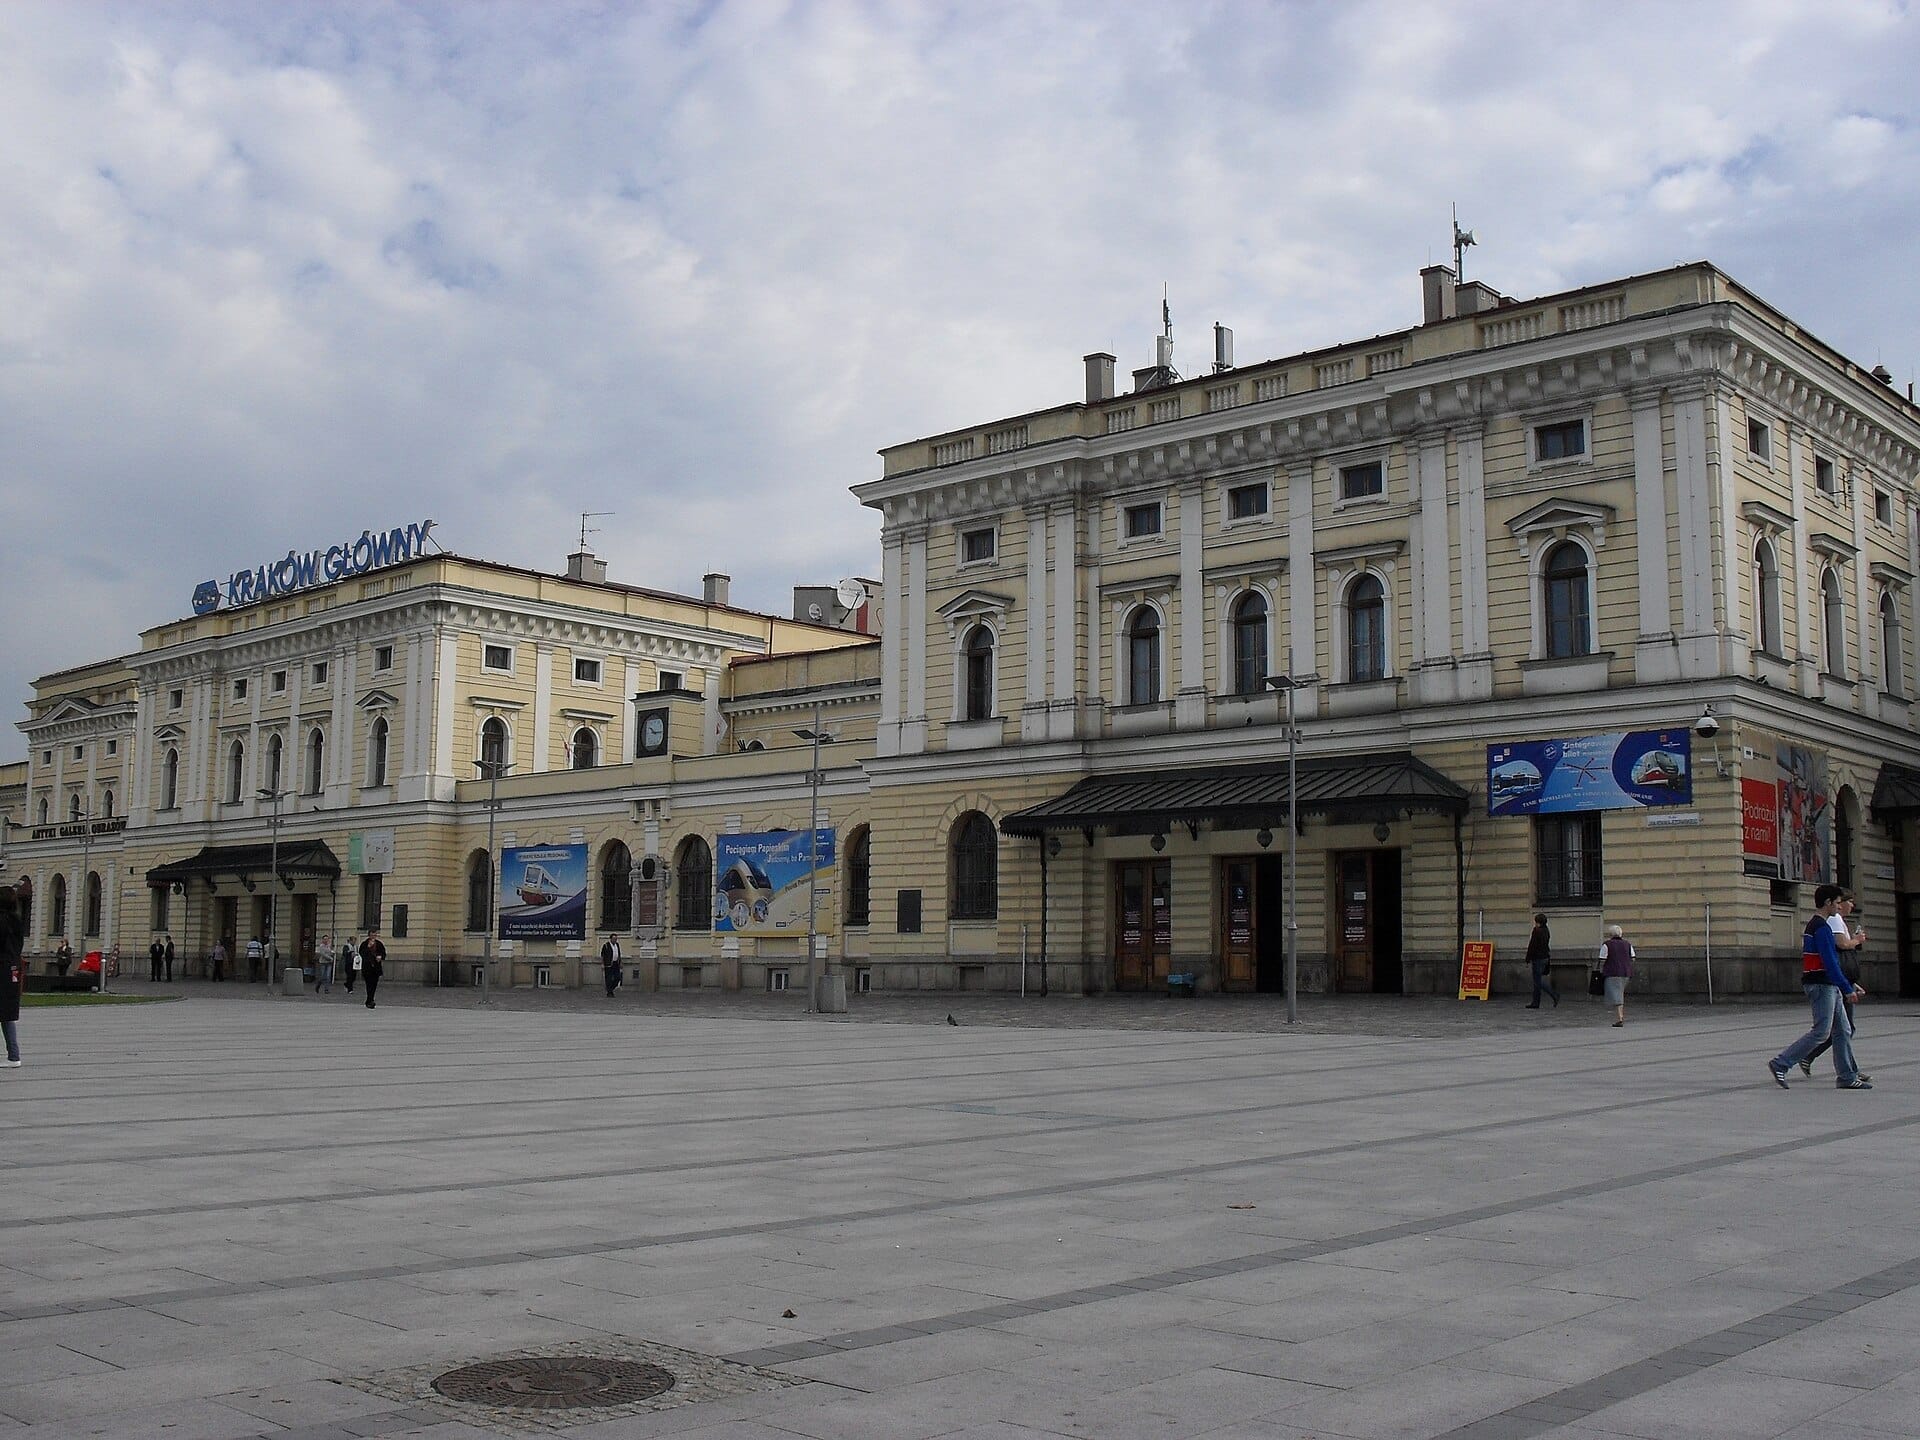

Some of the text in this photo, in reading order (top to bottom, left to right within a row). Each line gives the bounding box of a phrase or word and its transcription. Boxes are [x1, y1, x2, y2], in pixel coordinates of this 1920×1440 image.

[228, 519, 432, 605] KRAKÓW GŁÓWNY
[1743, 800, 1776, 826] Podróżuj
[1744, 826, 1771, 843] z nami!
